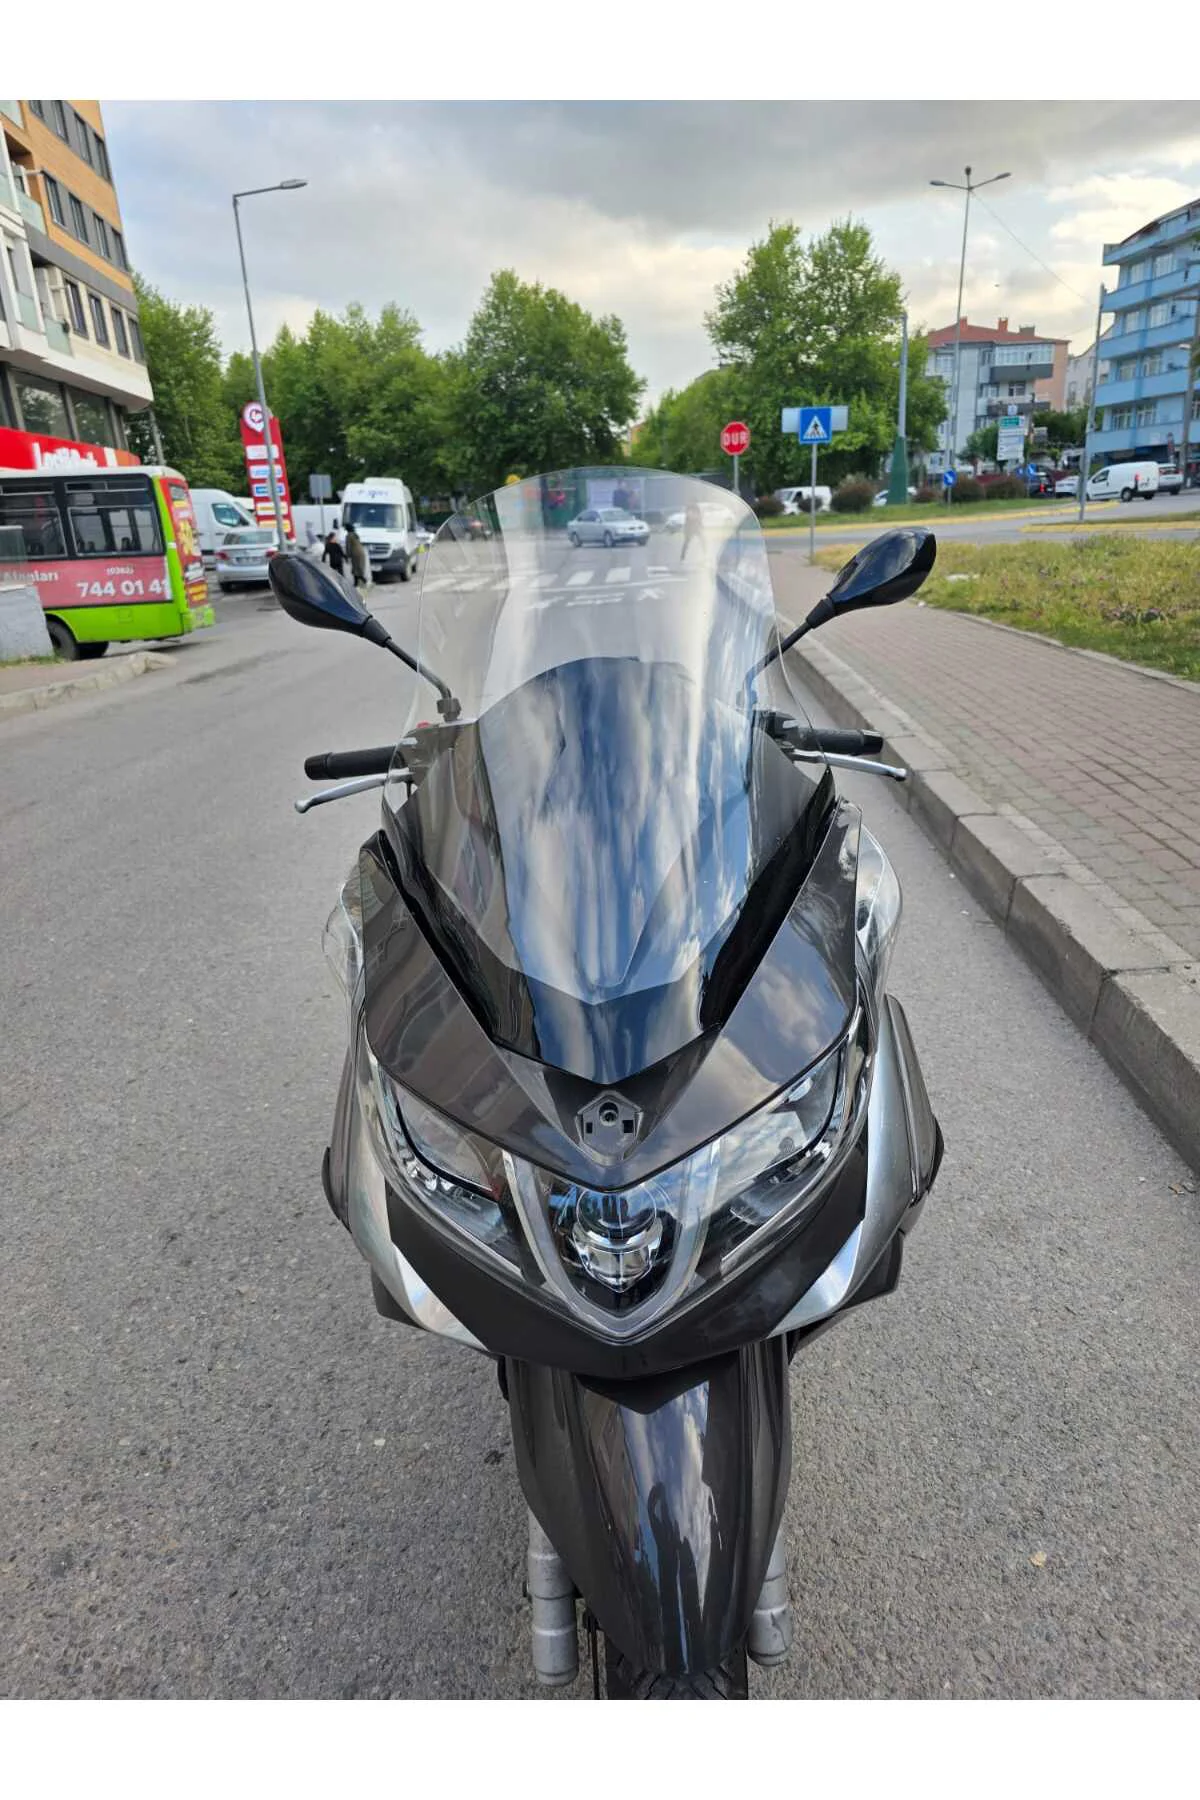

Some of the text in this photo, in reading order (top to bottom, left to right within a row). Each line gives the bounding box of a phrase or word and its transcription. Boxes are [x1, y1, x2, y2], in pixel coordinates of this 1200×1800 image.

[723, 431, 749, 446] DUR
[76, 580, 116, 598] 744
[121, 579, 144, 596] 01
